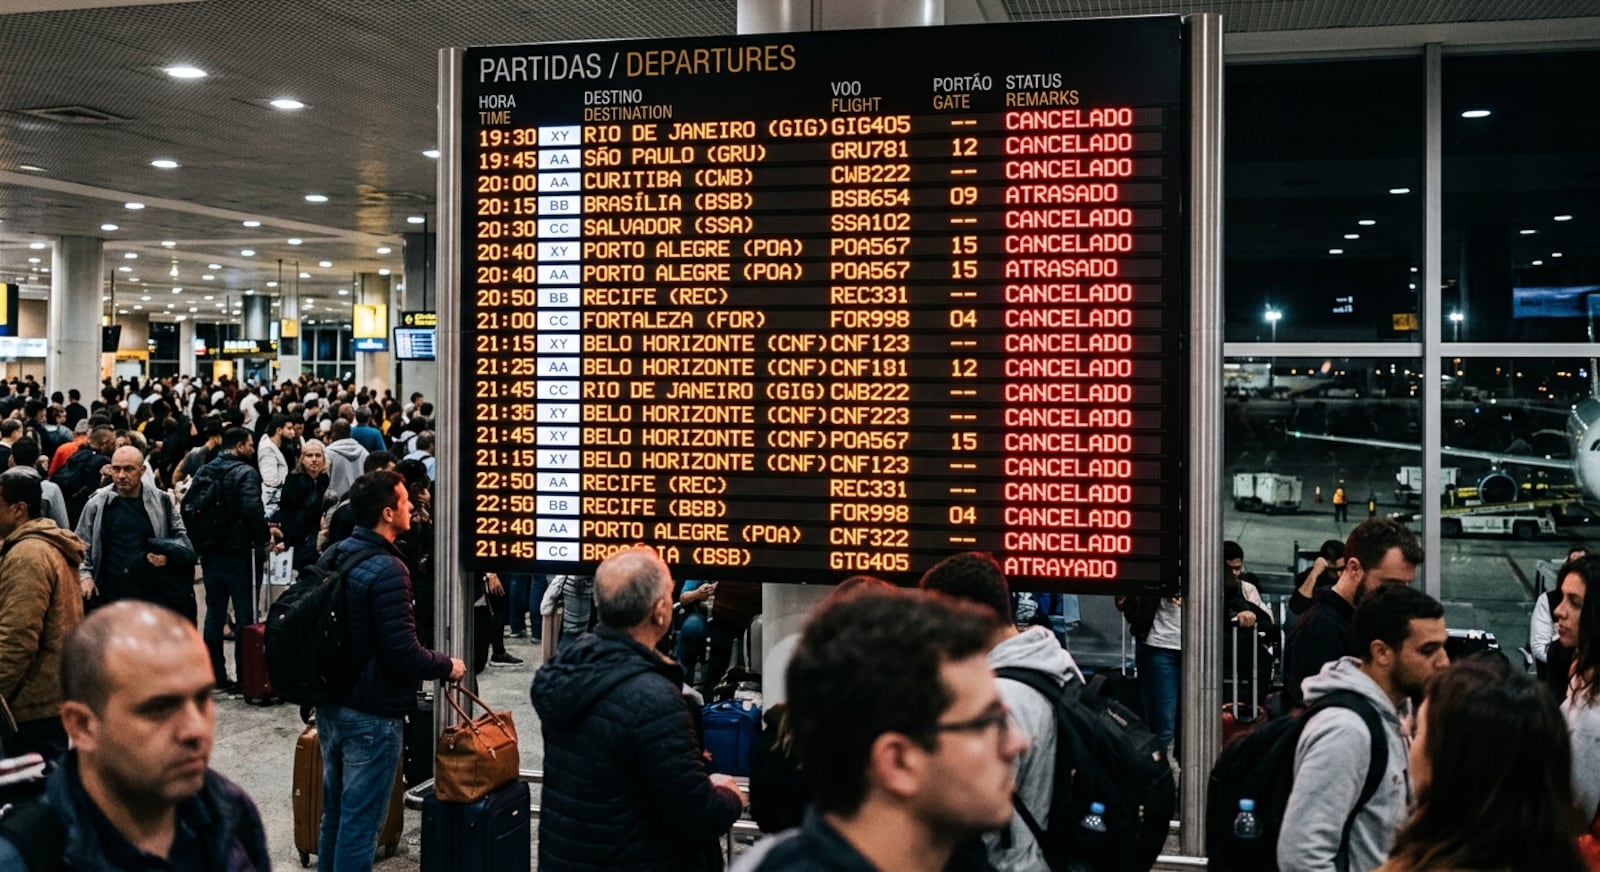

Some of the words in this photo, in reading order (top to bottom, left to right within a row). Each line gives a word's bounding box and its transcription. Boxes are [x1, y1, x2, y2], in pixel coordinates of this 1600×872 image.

[479, 53, 601, 82] PARTIDAS
[628, 45, 795, 76] DEPARTURES
[831, 81, 861, 96] VOO
[934, 73, 991, 91] PORTÃO
[1006, 73, 1061, 89] STATUS
[480, 95, 515, 108] HORA
[585, 89, 642, 104] DESTINO
[832, 97, 881, 112] FLIGHT
[934, 94, 969, 109] GATE
[1007, 88, 1079, 106] REMARKS
[479, 111, 510, 124] TIME
[585, 104, 672, 121] DESTINATION
[480, 128, 536, 147] 19:30
[551, 130, 569, 142] XY
[584, 125, 621, 143] RIO
[632, 124, 657, 142] DE
[668, 120, 756, 141] JANEIRO
[768, 118, 828, 137] (GIG)
[831, 115, 911, 136] GIG405
[1005, 107, 1133, 130] CANCELADO
[479, 151, 536, 170] 19:45
[549, 153, 570, 165] AA
[584, 146, 622, 167] SÃO
[632, 146, 695, 165] PAULO
[707, 144, 766, 163] (GRU)
[831, 140, 909, 160] GRU781
[952, 137, 978, 157] 12
[1005, 132, 1133, 155] CANCELADO
[478, 174, 536, 193] 20:00
[550, 176, 569, 188] AA
[584, 169, 682, 190] CURITIBA
[694, 168, 753, 187] (CWB)
[831, 163, 911, 184] CWB222
[1005, 157, 1133, 180] CANCELADO
[477, 197, 536, 216] 20:15
[549, 199, 569, 211] BB
[584, 191, 682, 213] BRASÍLIA
[694, 192, 753, 211] (BSB)
[831, 188, 911, 208] BSB654
[950, 186, 978, 206] 09
[1005, 183, 1119, 204] ATRASADO
[477, 220, 536, 239] 20:30
[549, 223, 569, 234] CC
[584, 217, 682, 236] SALVADOR
[694, 215, 753, 234] (SSA)
[831, 212, 911, 232] SSA102
[1005, 208, 1133, 229] CANCELADO
[477, 243, 536, 261] 20:40
[550, 246, 569, 257] XY
[583, 241, 645, 259] PORTO
[655, 239, 731, 258] ALEGRE
[743, 238, 803, 257] (POA)
[830, 236, 911, 256] POA567
[952, 235, 978, 255] 15
[1004, 232, 1133, 254] CANCELADO
[477, 265, 536, 284] 20:40
[549, 269, 569, 280] AA
[583, 264, 645, 282] PORTO
[655, 263, 731, 282] ALEGRE
[743, 262, 803, 281] (POA)
[830, 261, 911, 280] POA567
[952, 260, 978, 279] 15
[1005, 258, 1119, 278] ATRASADO
[477, 288, 536, 307] 20:50
[549, 292, 569, 304] BB
[583, 287, 657, 306] RECIFE
[669, 287, 728, 305] (REC)
[830, 285, 908, 305] REC331
[1004, 283, 1133, 304] CANCELADO
[477, 311, 536, 330] 21:00
[549, 315, 569, 327] CC
[583, 311, 694, 329] FORTALEZA
[706, 310, 766, 329] (FOR)
[830, 310, 910, 328] FOR998
[949, 309, 978, 328] 04
[1004, 308, 1132, 328] CANCELADO
[477, 334, 536, 353] 21:15
[550, 338, 568, 349] XY
[583, 334, 633, 352] BELO
[642, 334, 755, 352] HORIZONTE
[767, 334, 828, 352] (CNF)
[830, 334, 910, 353] CNF123
[1004, 333, 1133, 353] CANCELADO
[476, 357, 536, 376] 21:25
[548, 361, 569, 372] AA
[583, 357, 632, 376] BELO
[642, 358, 755, 376] HORIZONTE
[767, 358, 827, 376] (CNF)
[951, 358, 978, 377] 12
[1004, 358, 1132, 378] CANCELADO
[476, 380, 536, 399] 21:45
[549, 384, 568, 396] CC
[583, 381, 620, 399] RIO
[630, 381, 656, 399] DE
[666, 381, 754, 400] JANEIRO
[766, 382, 825, 401] (GIG)
[830, 382, 910, 401] CWB222
[1004, 383, 1132, 403] CANCELADO
[476, 403, 536, 422] 21:35
[549, 407, 568, 419] XY
[583, 404, 632, 422] BELO
[642, 404, 755, 424] HORIZONTE
[767, 405, 827, 425] (CNF)
[830, 406, 910, 425] CNF223
[1004, 407, 1132, 428] CANCELADO
[476, 426, 536, 445] 21:45
[550, 430, 568, 441] XY
[583, 427, 632, 445] BELO
[642, 428, 755, 448] HORIZONTE
[767, 430, 827, 449] (CNF)
[830, 430, 910, 450] POA567
[951, 432, 977, 451] 15
[1004, 432, 1132, 453] CANCELADO
[476, 449, 536, 468] 21:15
[549, 453, 568, 465] XY
[583, 450, 632, 469] BELO
[642, 451, 755, 471] HORIZONTE
[767, 453, 827, 472] (CNF)
[830, 454, 910, 474] CNF123
[1004, 457, 1132, 479] CANCELADO
[476, 471, 536, 491] 22:50
[548, 476, 568, 488] AA
[582, 473, 656, 493] RECIFE
[668, 475, 727, 494] (REC)
[830, 478, 907, 498] REC331
[1004, 482, 1132, 504] CANCELADO
[549, 500, 568, 511] BB
[583, 496, 656, 516] RECIFE
[830, 503, 909, 523] FOR998
[949, 505, 977, 525] 04
[1004, 506, 1132, 529] CANCELADO
[476, 517, 536, 537] 22:40
[548, 522, 568, 534] AA
[582, 520, 644, 539] PORTO
[654, 522, 729, 542] ALEGRE
[742, 524, 801, 544] (POA)
[829, 527, 909, 548] CNF322
[1004, 531, 1132, 554] CANCELADO
[476, 540, 536, 560] 21:45
[548, 545, 568, 557] CC
[692, 547, 751, 566] (BSB)
[830, 551, 909, 571] GTG405
[1004, 556, 1117, 579] ATRAYADO
